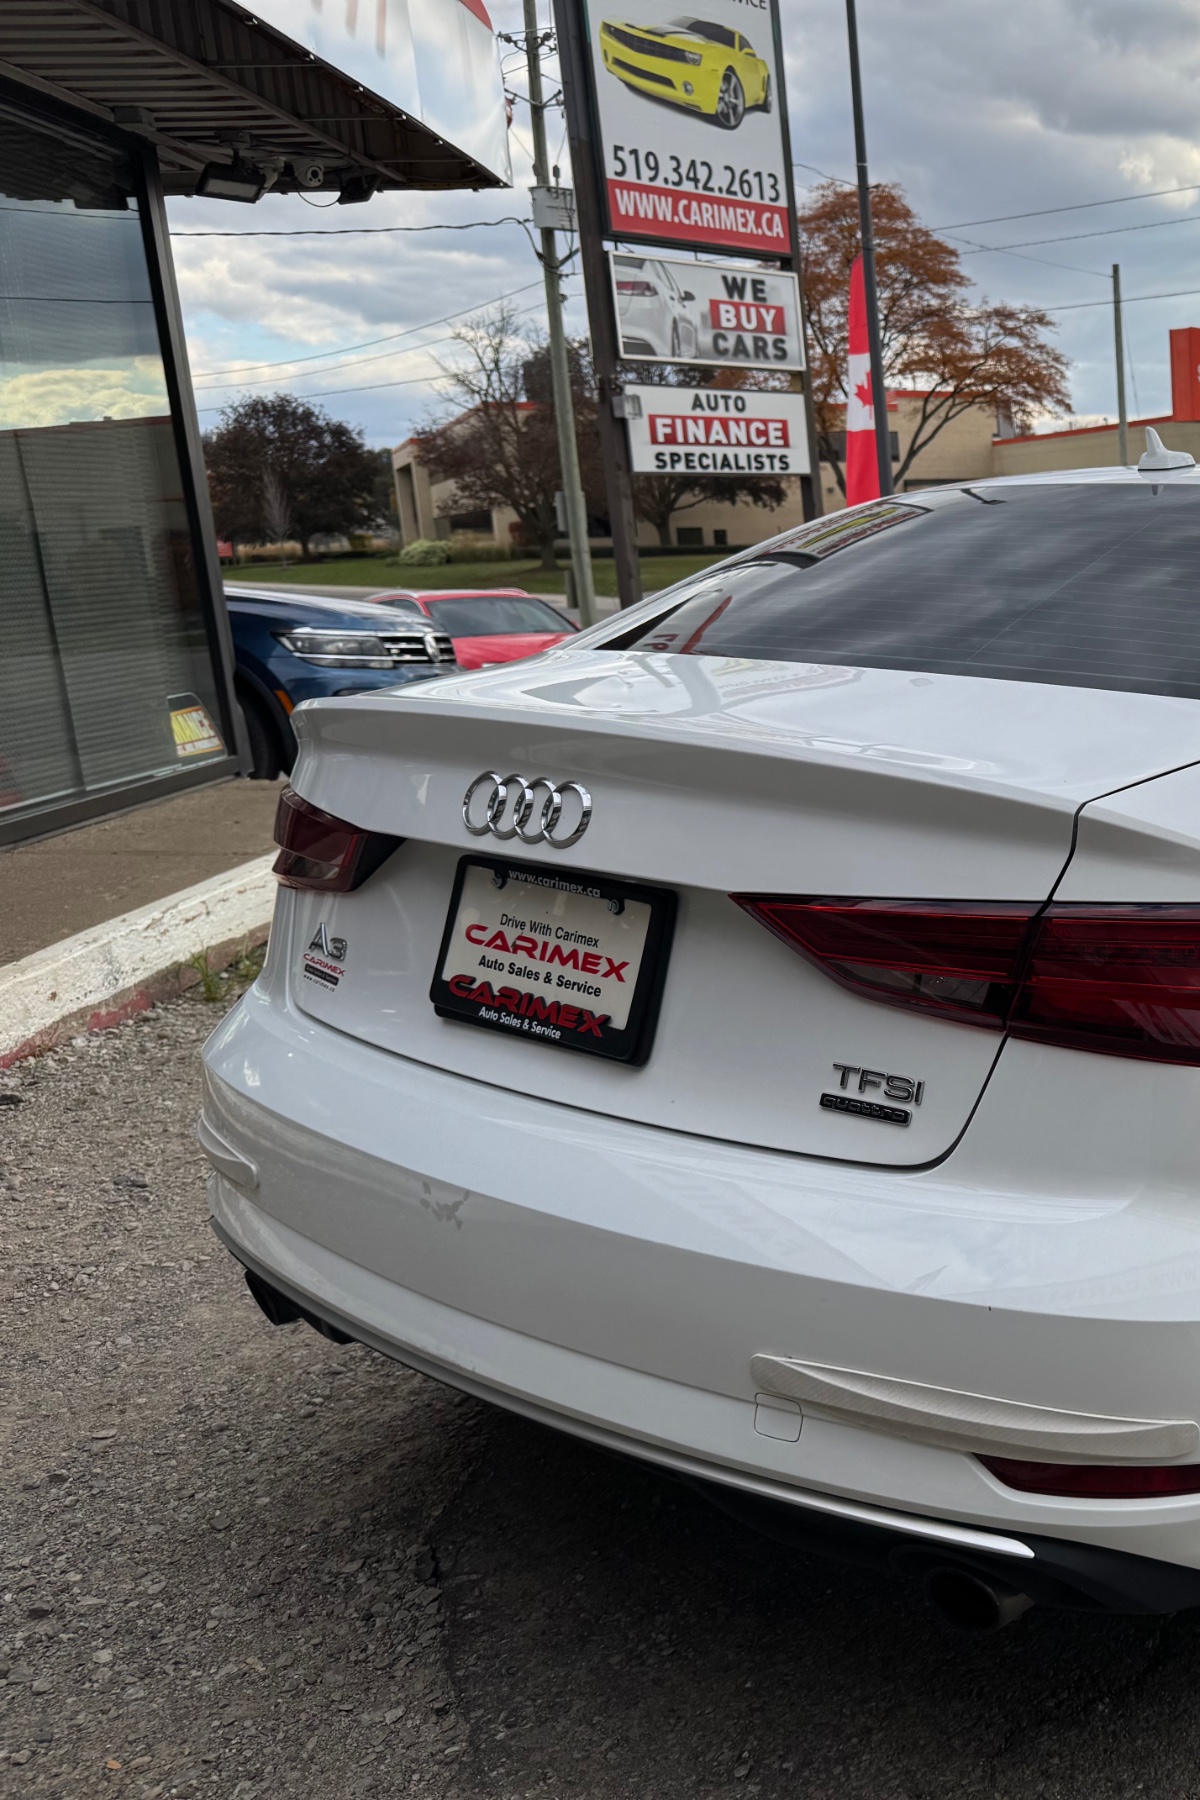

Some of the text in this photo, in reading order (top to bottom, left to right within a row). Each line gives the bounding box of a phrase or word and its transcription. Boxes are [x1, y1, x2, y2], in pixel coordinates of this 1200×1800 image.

[613, 144, 780, 203] 519.342.2613
[614, 188, 785, 239] WWW.CARIMEX.CA
[722, 275, 768, 303] WE
[719, 303, 777, 332] BUY
[713, 332, 788, 361] CARS
[691, 393, 747, 413] AUTO
[655, 417, 785, 446] FINANCE
[655, 452, 790, 472] SPECIALISTS
[508, 870, 601, 898] www.carimex.ca
[308, 922, 348, 962] A3
[500, 913, 600, 949] Drive With Carimex
[303, 953, 346, 977] CARIMEX
[465, 923, 630, 983] CARIMEX
[478, 955, 602, 998] Auto Sales & Service
[449, 974, 612, 1038] CARIMEX
[478, 1006, 562, 1040] Auto Sales & Service
[832, 1062, 925, 1105] TFSI
[823, 1096, 905, 1121] quattro
